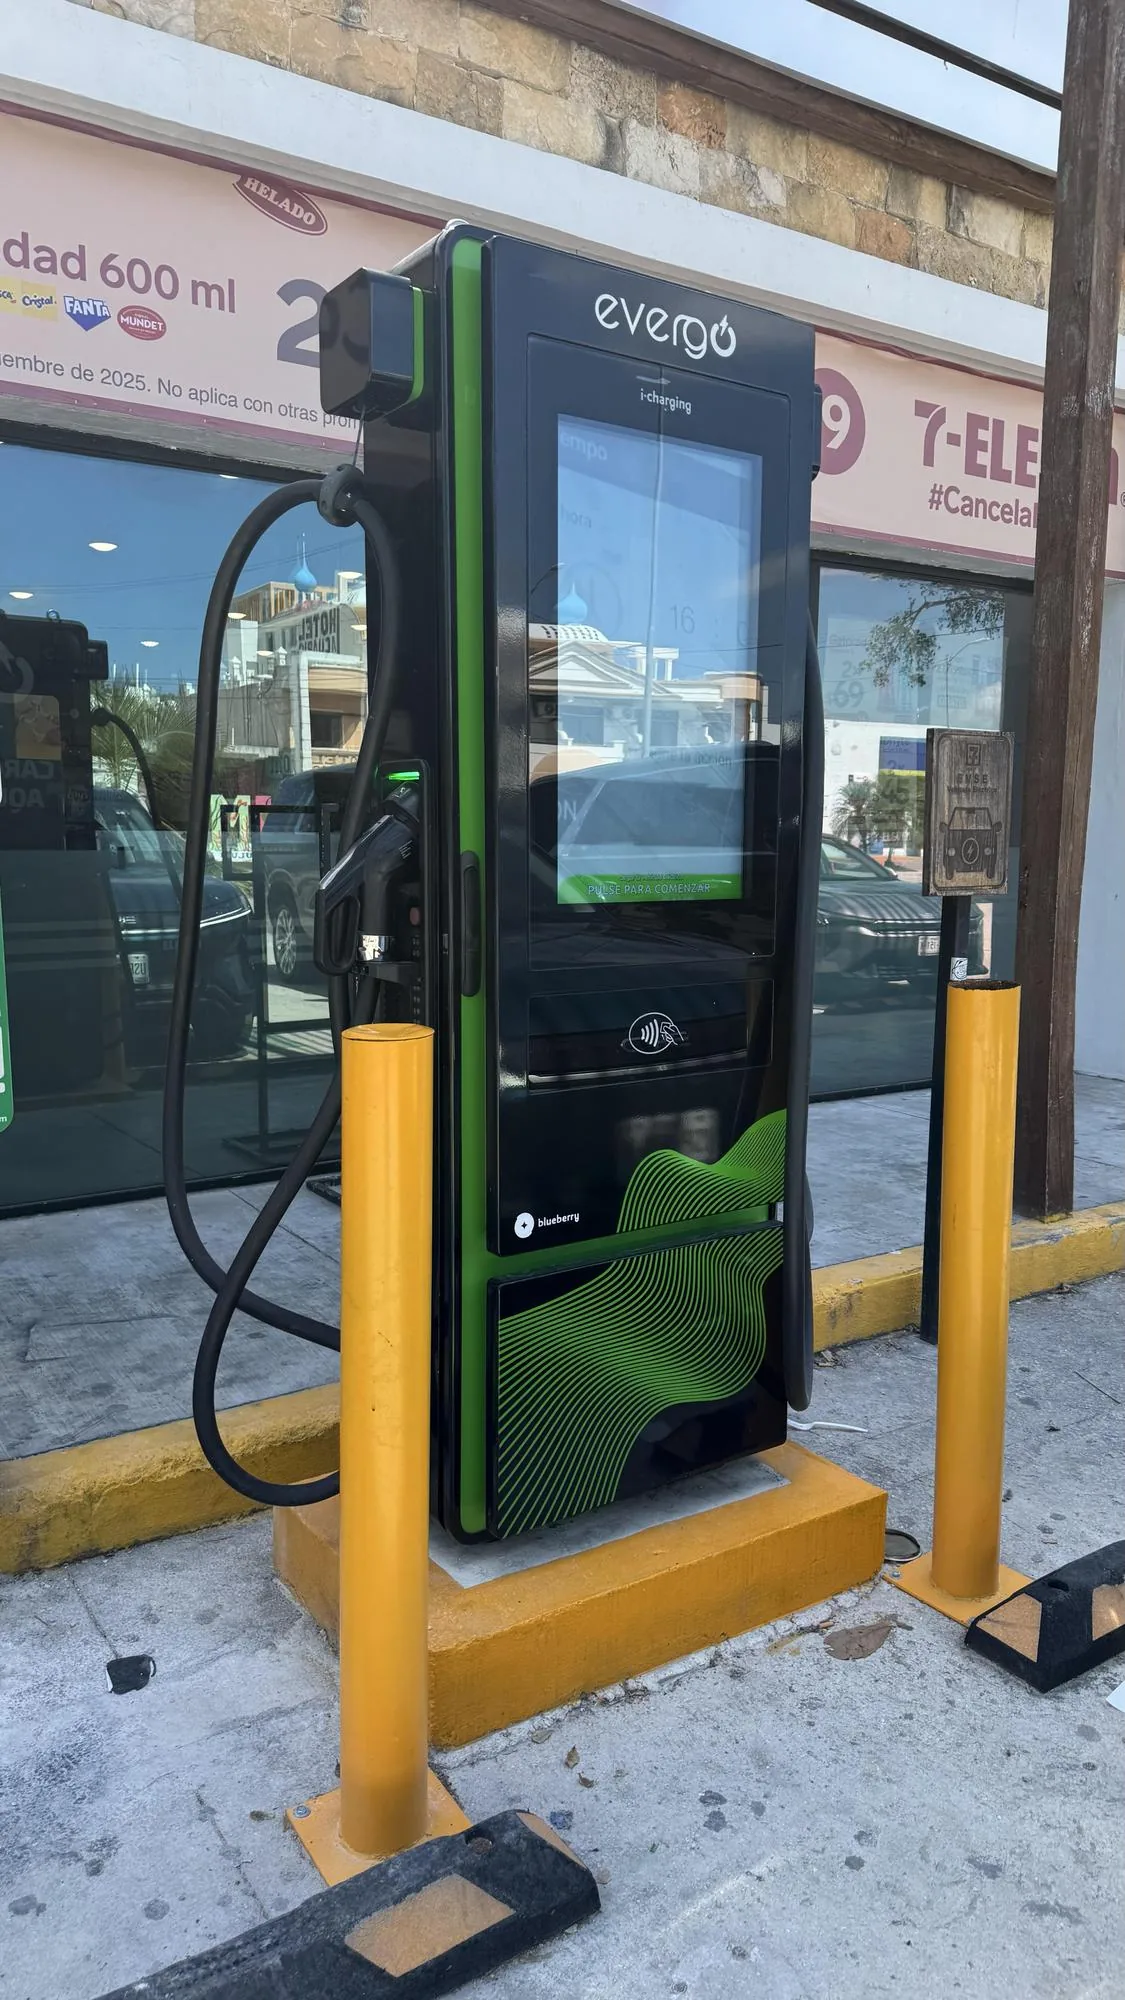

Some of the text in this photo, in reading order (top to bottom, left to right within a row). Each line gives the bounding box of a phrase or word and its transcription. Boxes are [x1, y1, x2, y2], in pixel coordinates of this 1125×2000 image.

[243, 177, 316, 225] HELADO
[100, 253, 179, 300] 600
[191, 278, 236, 313] ml
[64, 296, 110, 317] FANTA
[120, 314, 164, 331] MUNDET
[595, 293, 737, 360] evergo
[71, 363, 94, 382] de
[100, 368, 151, 392] 2025.
[157, 377, 183, 398] No
[188, 386, 239, 408] aplica
[243, 397, 273, 414] con
[278, 402, 318, 422] otras
[640, 387, 692, 415] i-charging
[821, 394, 851, 450] 9
[588, 883, 711, 895] PULSE PARA COMENZAR
[537, 1213, 580, 1228] blueberry
